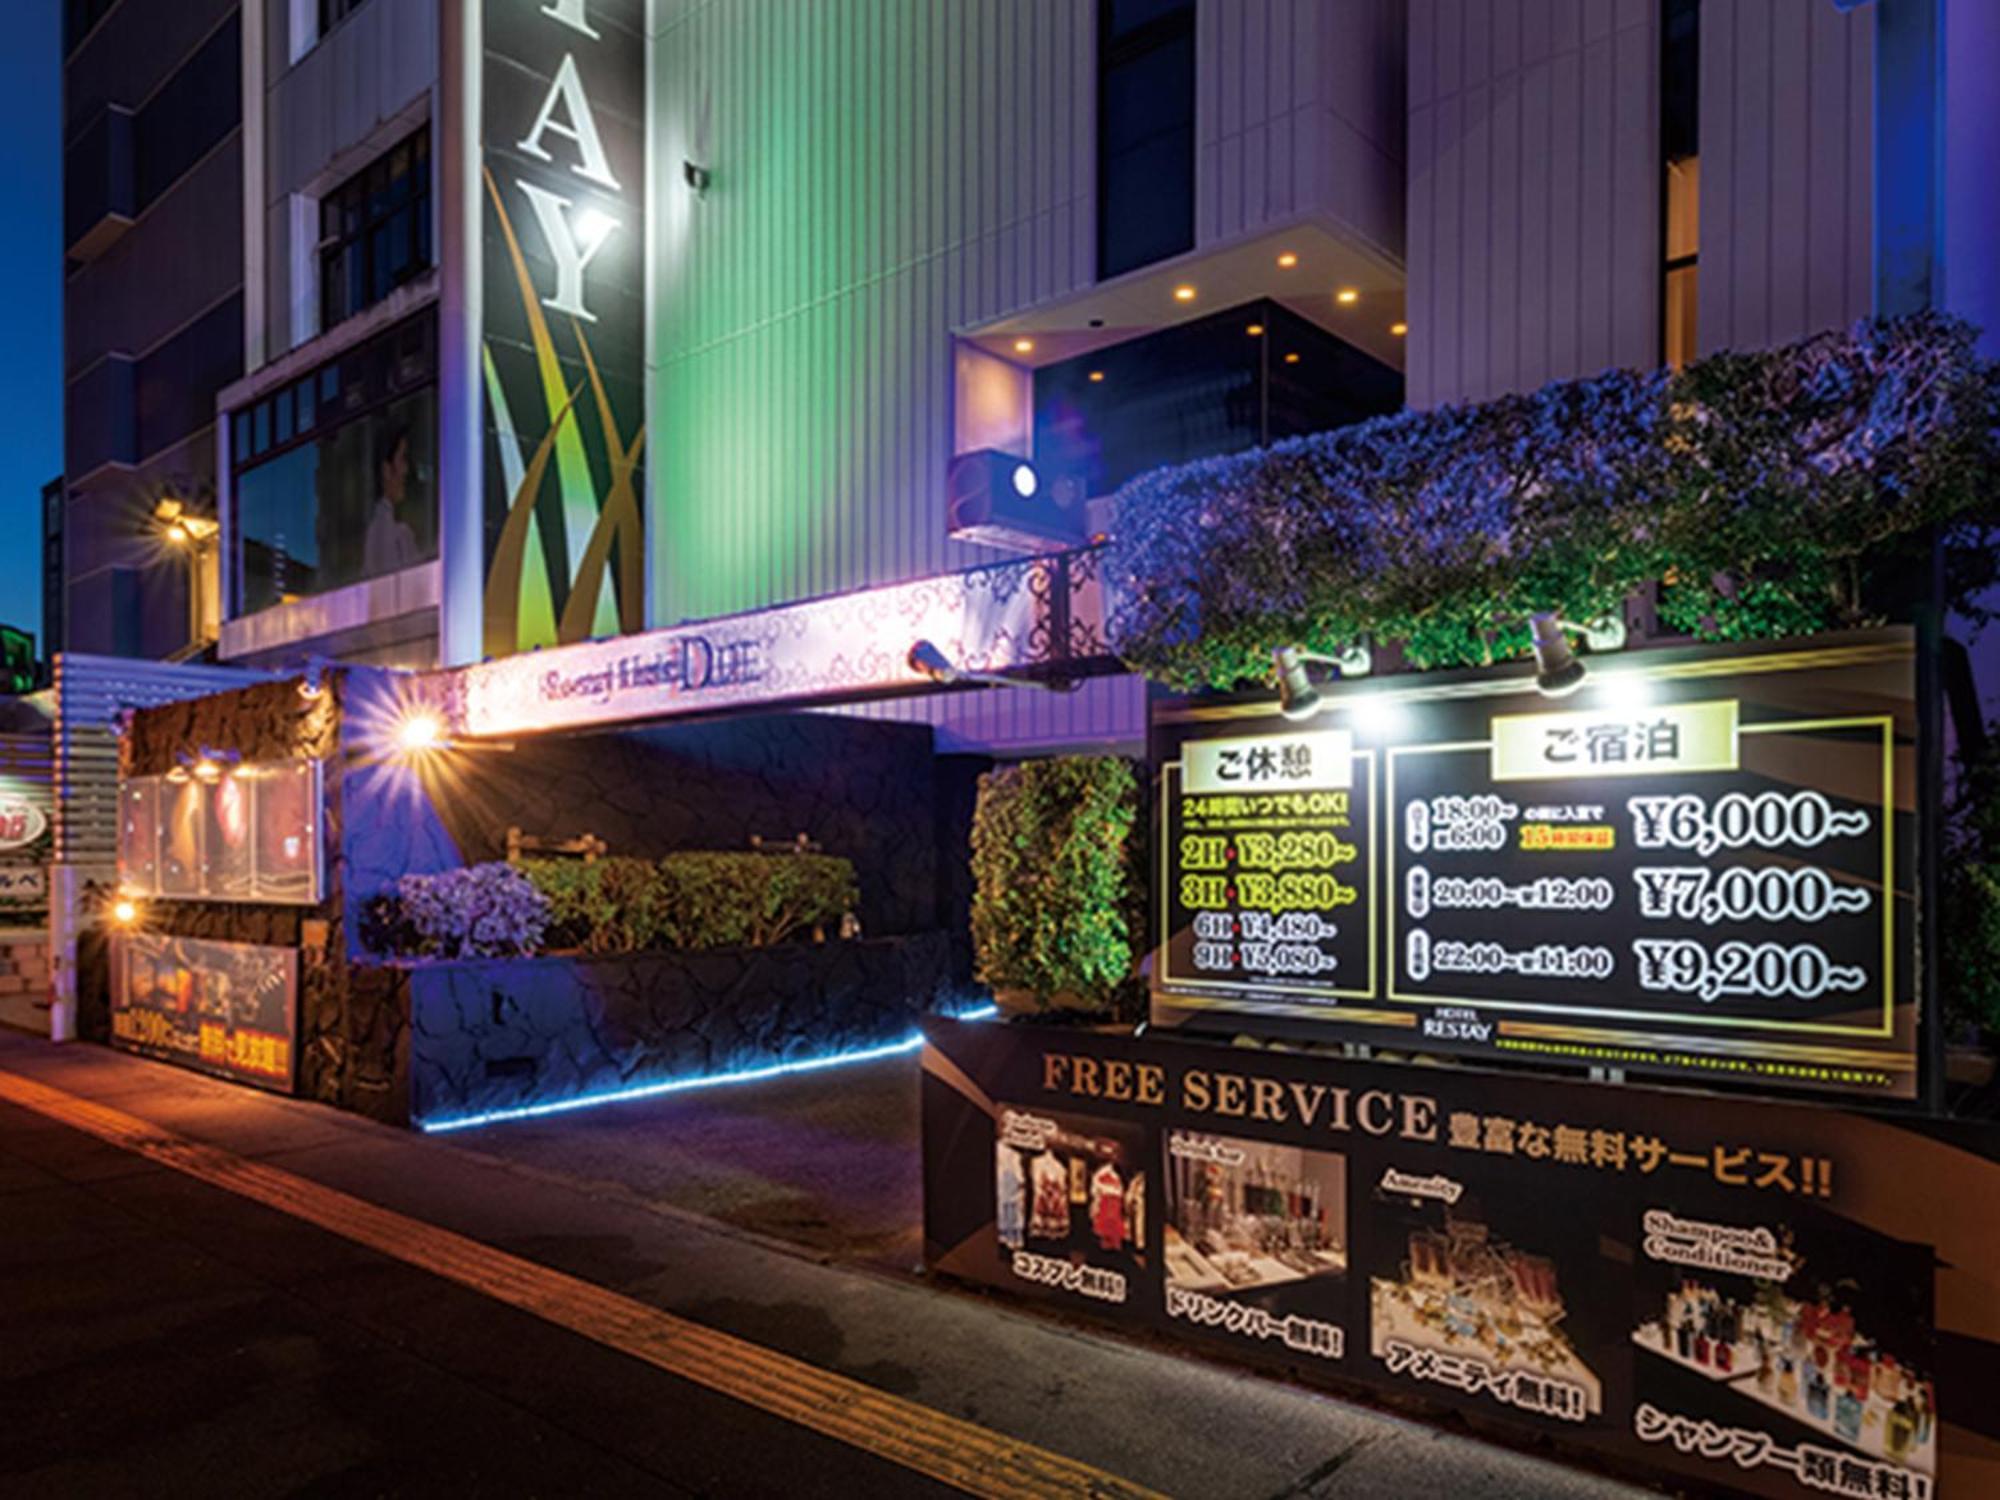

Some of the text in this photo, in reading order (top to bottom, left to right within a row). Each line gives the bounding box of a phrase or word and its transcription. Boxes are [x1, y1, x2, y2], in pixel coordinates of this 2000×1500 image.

[1217, 744, 1312, 780] ご休憩
[1543, 718, 1680, 763] ご宿泊
[1627, 792, 1870, 857] ¥6,000~
[1633, 866, 1871, 924] ¥7,000~
[1633, 939, 1867, 1002] ¥9,200~
[1424, 1019, 1492, 1041] RESTAY
[1043, 1053, 1165, 1104] FREE
[1183, 1070, 1438, 1141] SERVICE
[1643, 1235, 1792, 1282] Conditioner
[1386, 1341, 1586, 1421] アメニティ無料!
